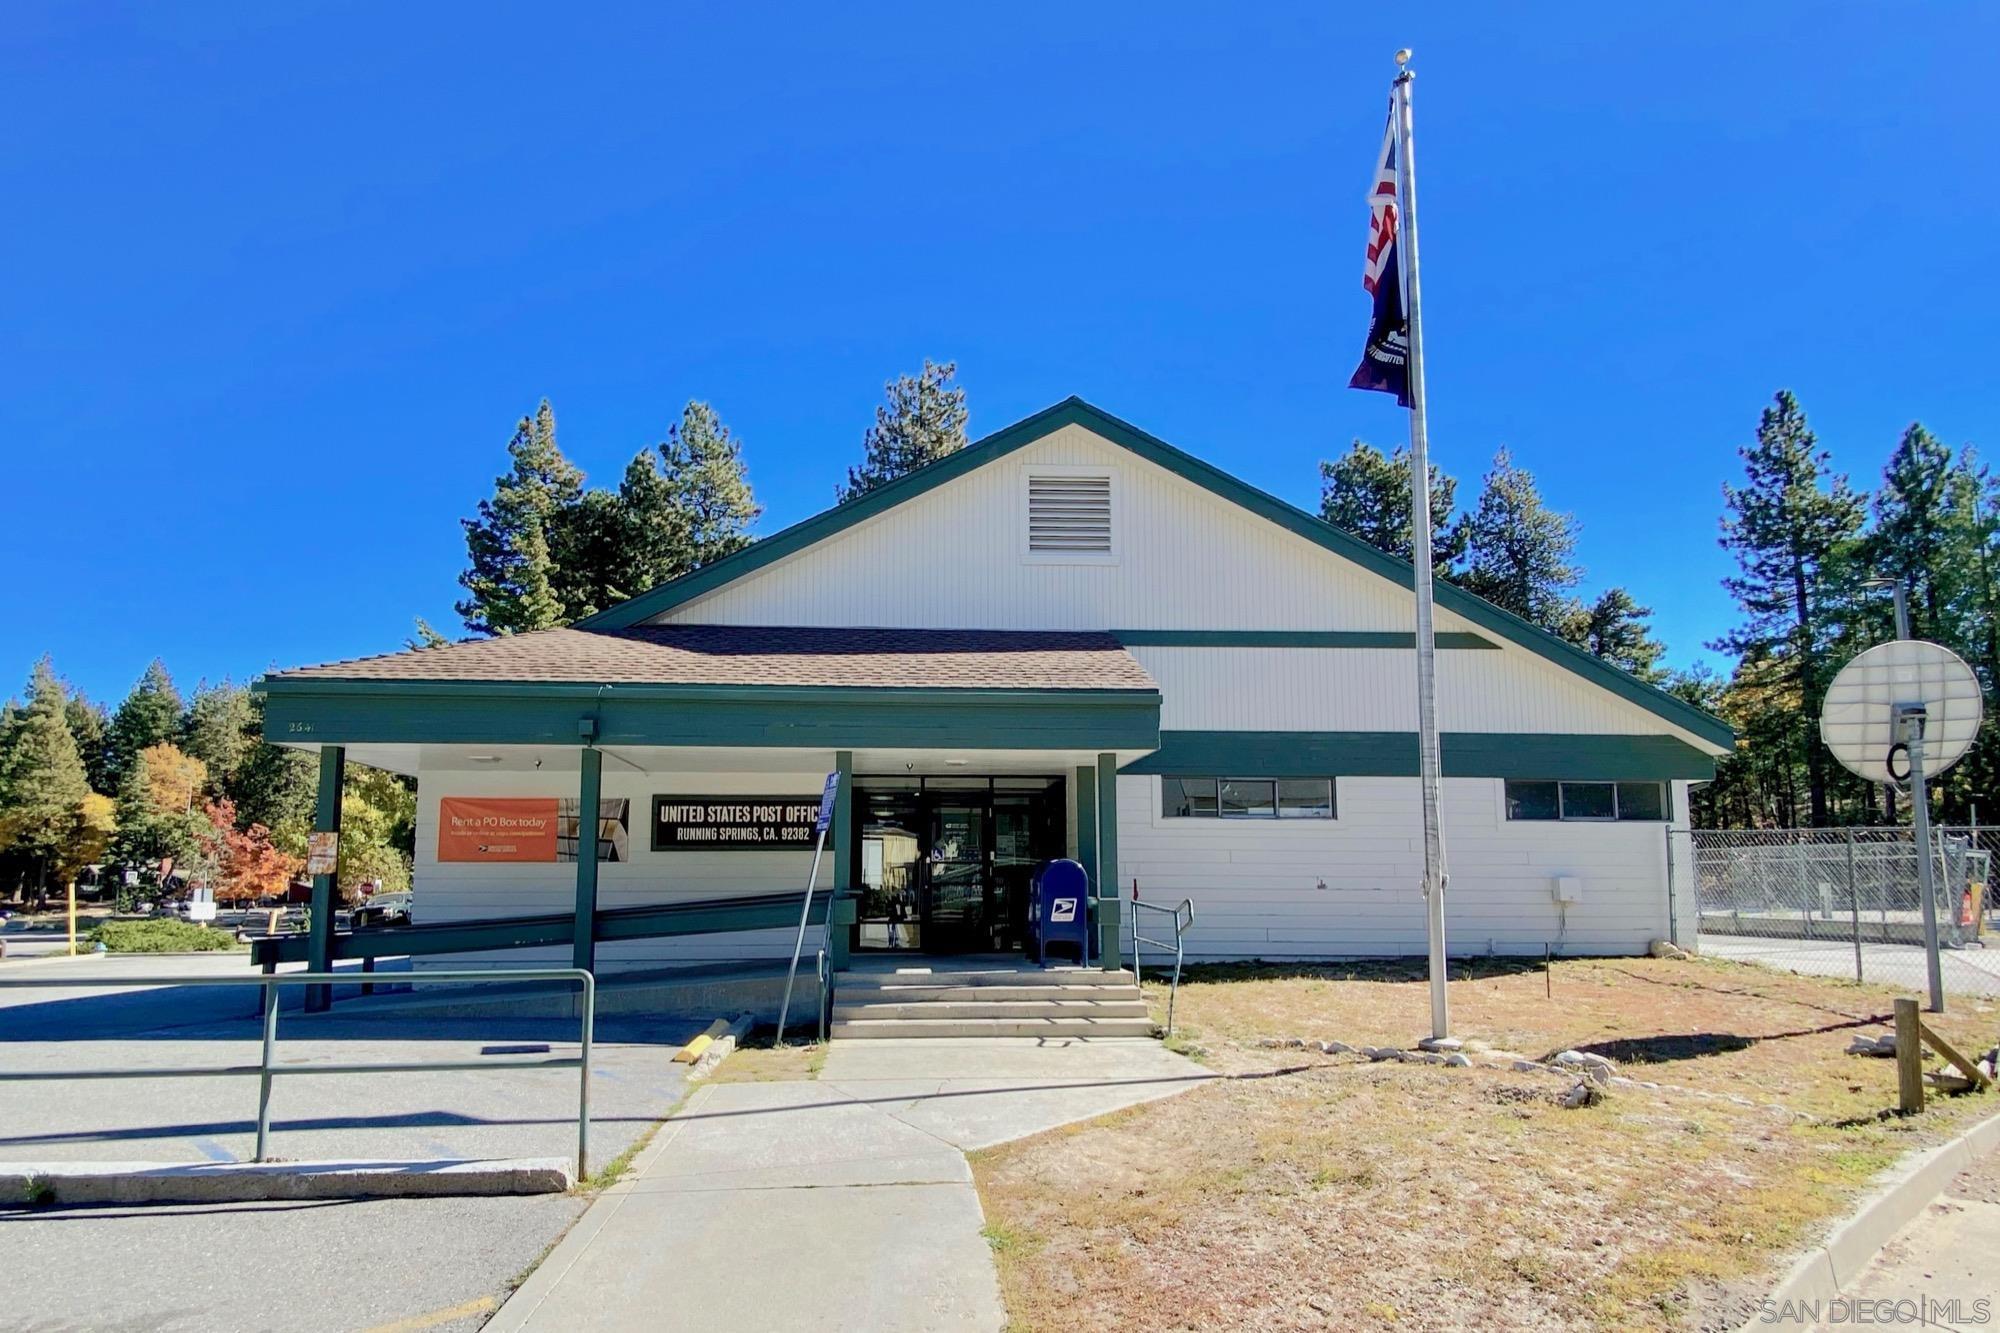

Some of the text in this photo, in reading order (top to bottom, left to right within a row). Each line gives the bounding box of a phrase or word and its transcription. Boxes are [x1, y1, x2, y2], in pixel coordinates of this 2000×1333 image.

[660, 805, 822, 823] UNITED STATES POST OFFIC
[451, 816, 474, 827] Rent
[483, 816, 498, 827] PO
[499, 816, 518, 827] Box
[519, 816, 547, 830] today
[677, 827, 810, 842] RUNNING SPRINGS, CA. 92382
